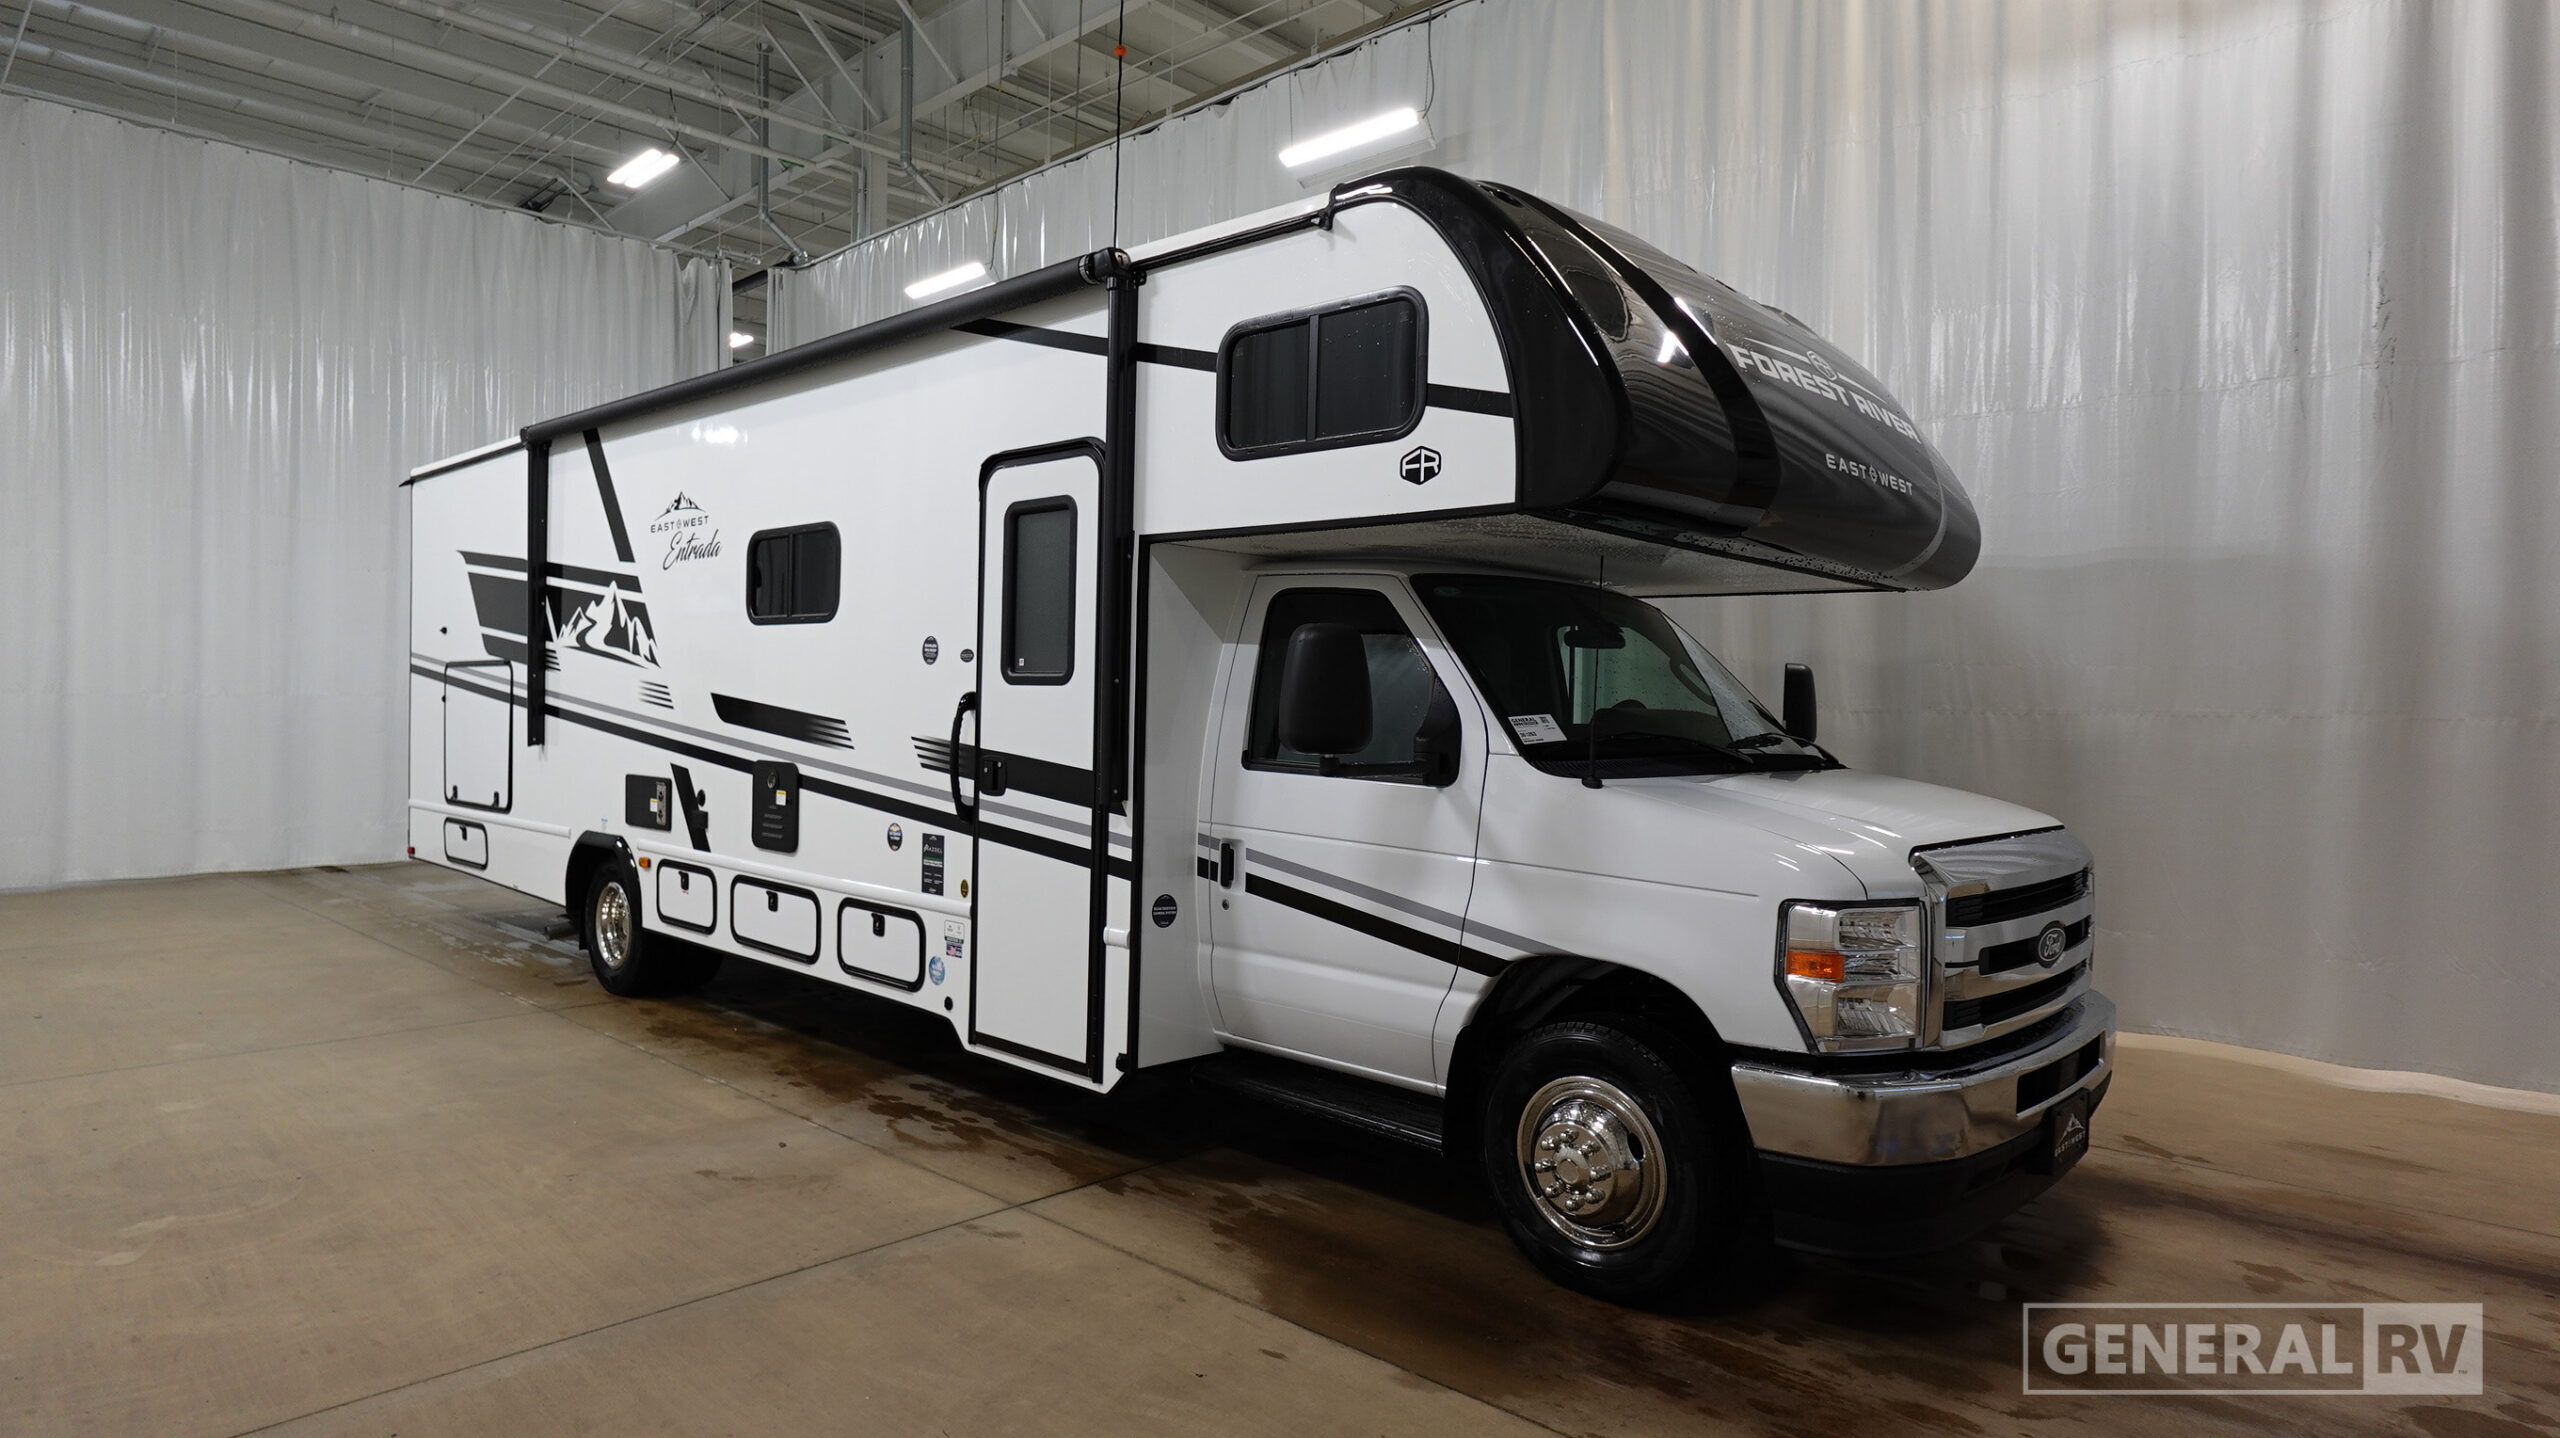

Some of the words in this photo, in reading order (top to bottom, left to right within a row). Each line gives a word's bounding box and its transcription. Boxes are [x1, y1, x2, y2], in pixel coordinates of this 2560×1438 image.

[1726, 342, 1850, 406] FOREST
[1850, 391, 1922, 444] RIVER
[1825, 453, 1867, 480] EAST
[1877, 470, 1913, 496] WEST
[650, 521, 675, 533] EAST
[682, 515, 709, 528] WEST
[662, 528, 722, 571] Entrada
